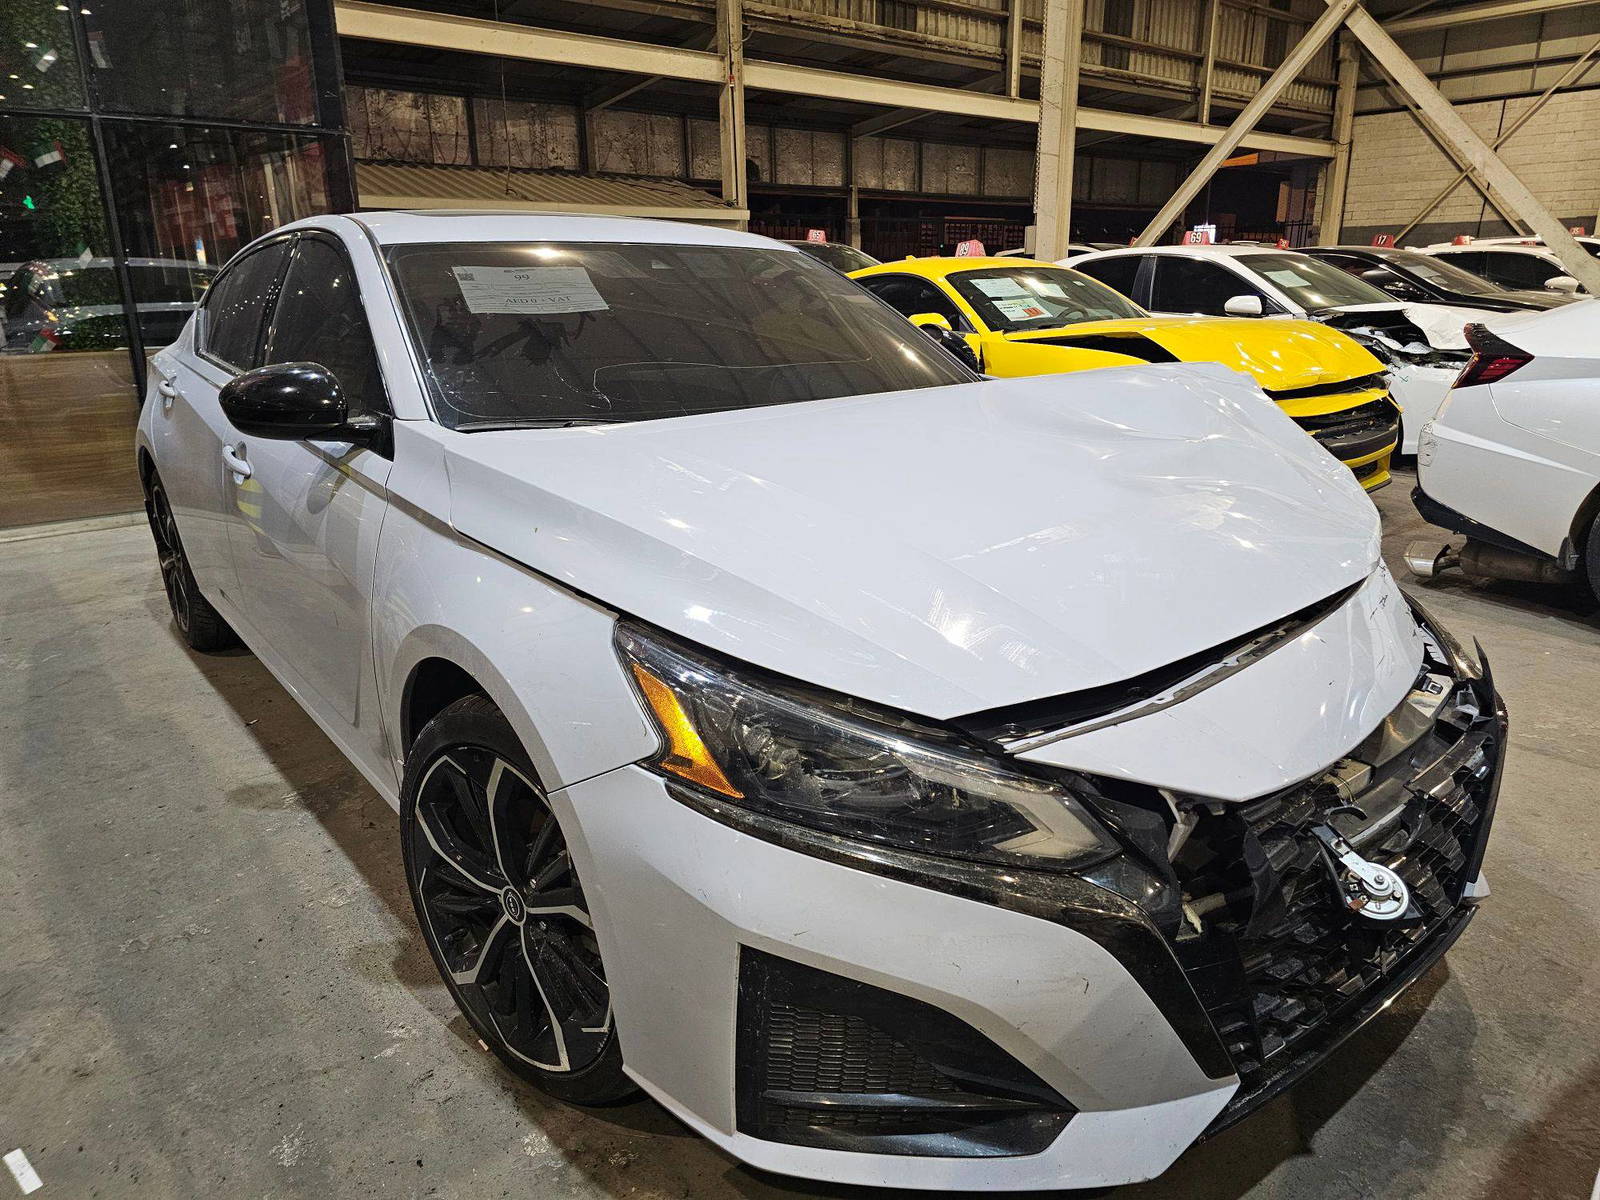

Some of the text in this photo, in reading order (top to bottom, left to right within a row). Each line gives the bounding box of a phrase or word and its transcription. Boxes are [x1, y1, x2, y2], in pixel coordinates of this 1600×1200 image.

[1190, 232, 1202, 244] 69
[1377, 235, 1388, 246] 17
[514, 273, 531, 281] 99
[548, 295, 572, 303] VAT
